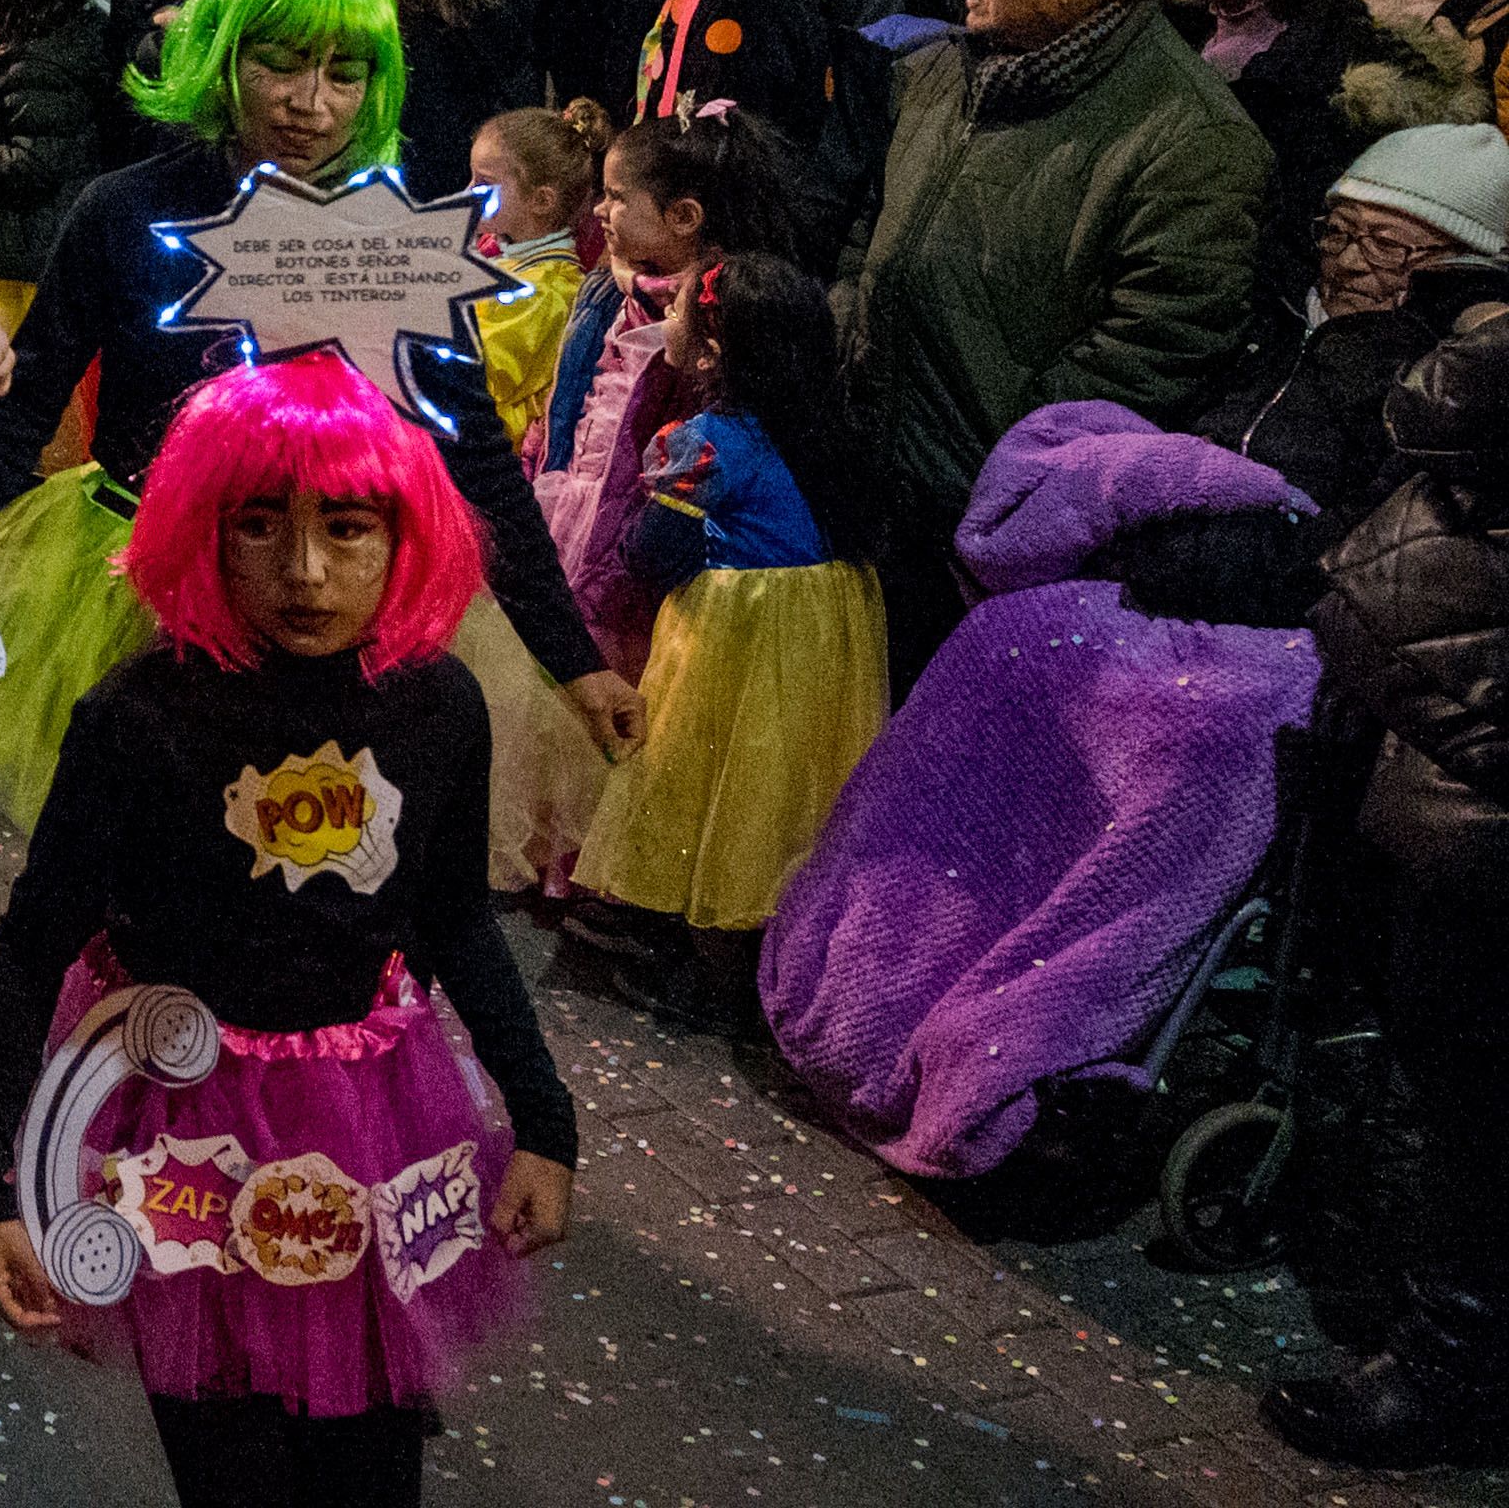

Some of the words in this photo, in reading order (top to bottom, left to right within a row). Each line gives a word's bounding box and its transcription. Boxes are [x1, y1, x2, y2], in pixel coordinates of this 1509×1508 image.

[233, 239, 271, 253] DEBE
[278, 239, 306, 252] SER
[311, 238, 355, 251] COSA
[362, 237, 391, 250] DEL
[396, 236, 453, 249] NUEVO
[275, 254, 351, 269] BOTONES
[375, 271, 461, 284] LLENANDO
[283, 290, 313, 303] LOS
[255, 783, 365, 843] POW
